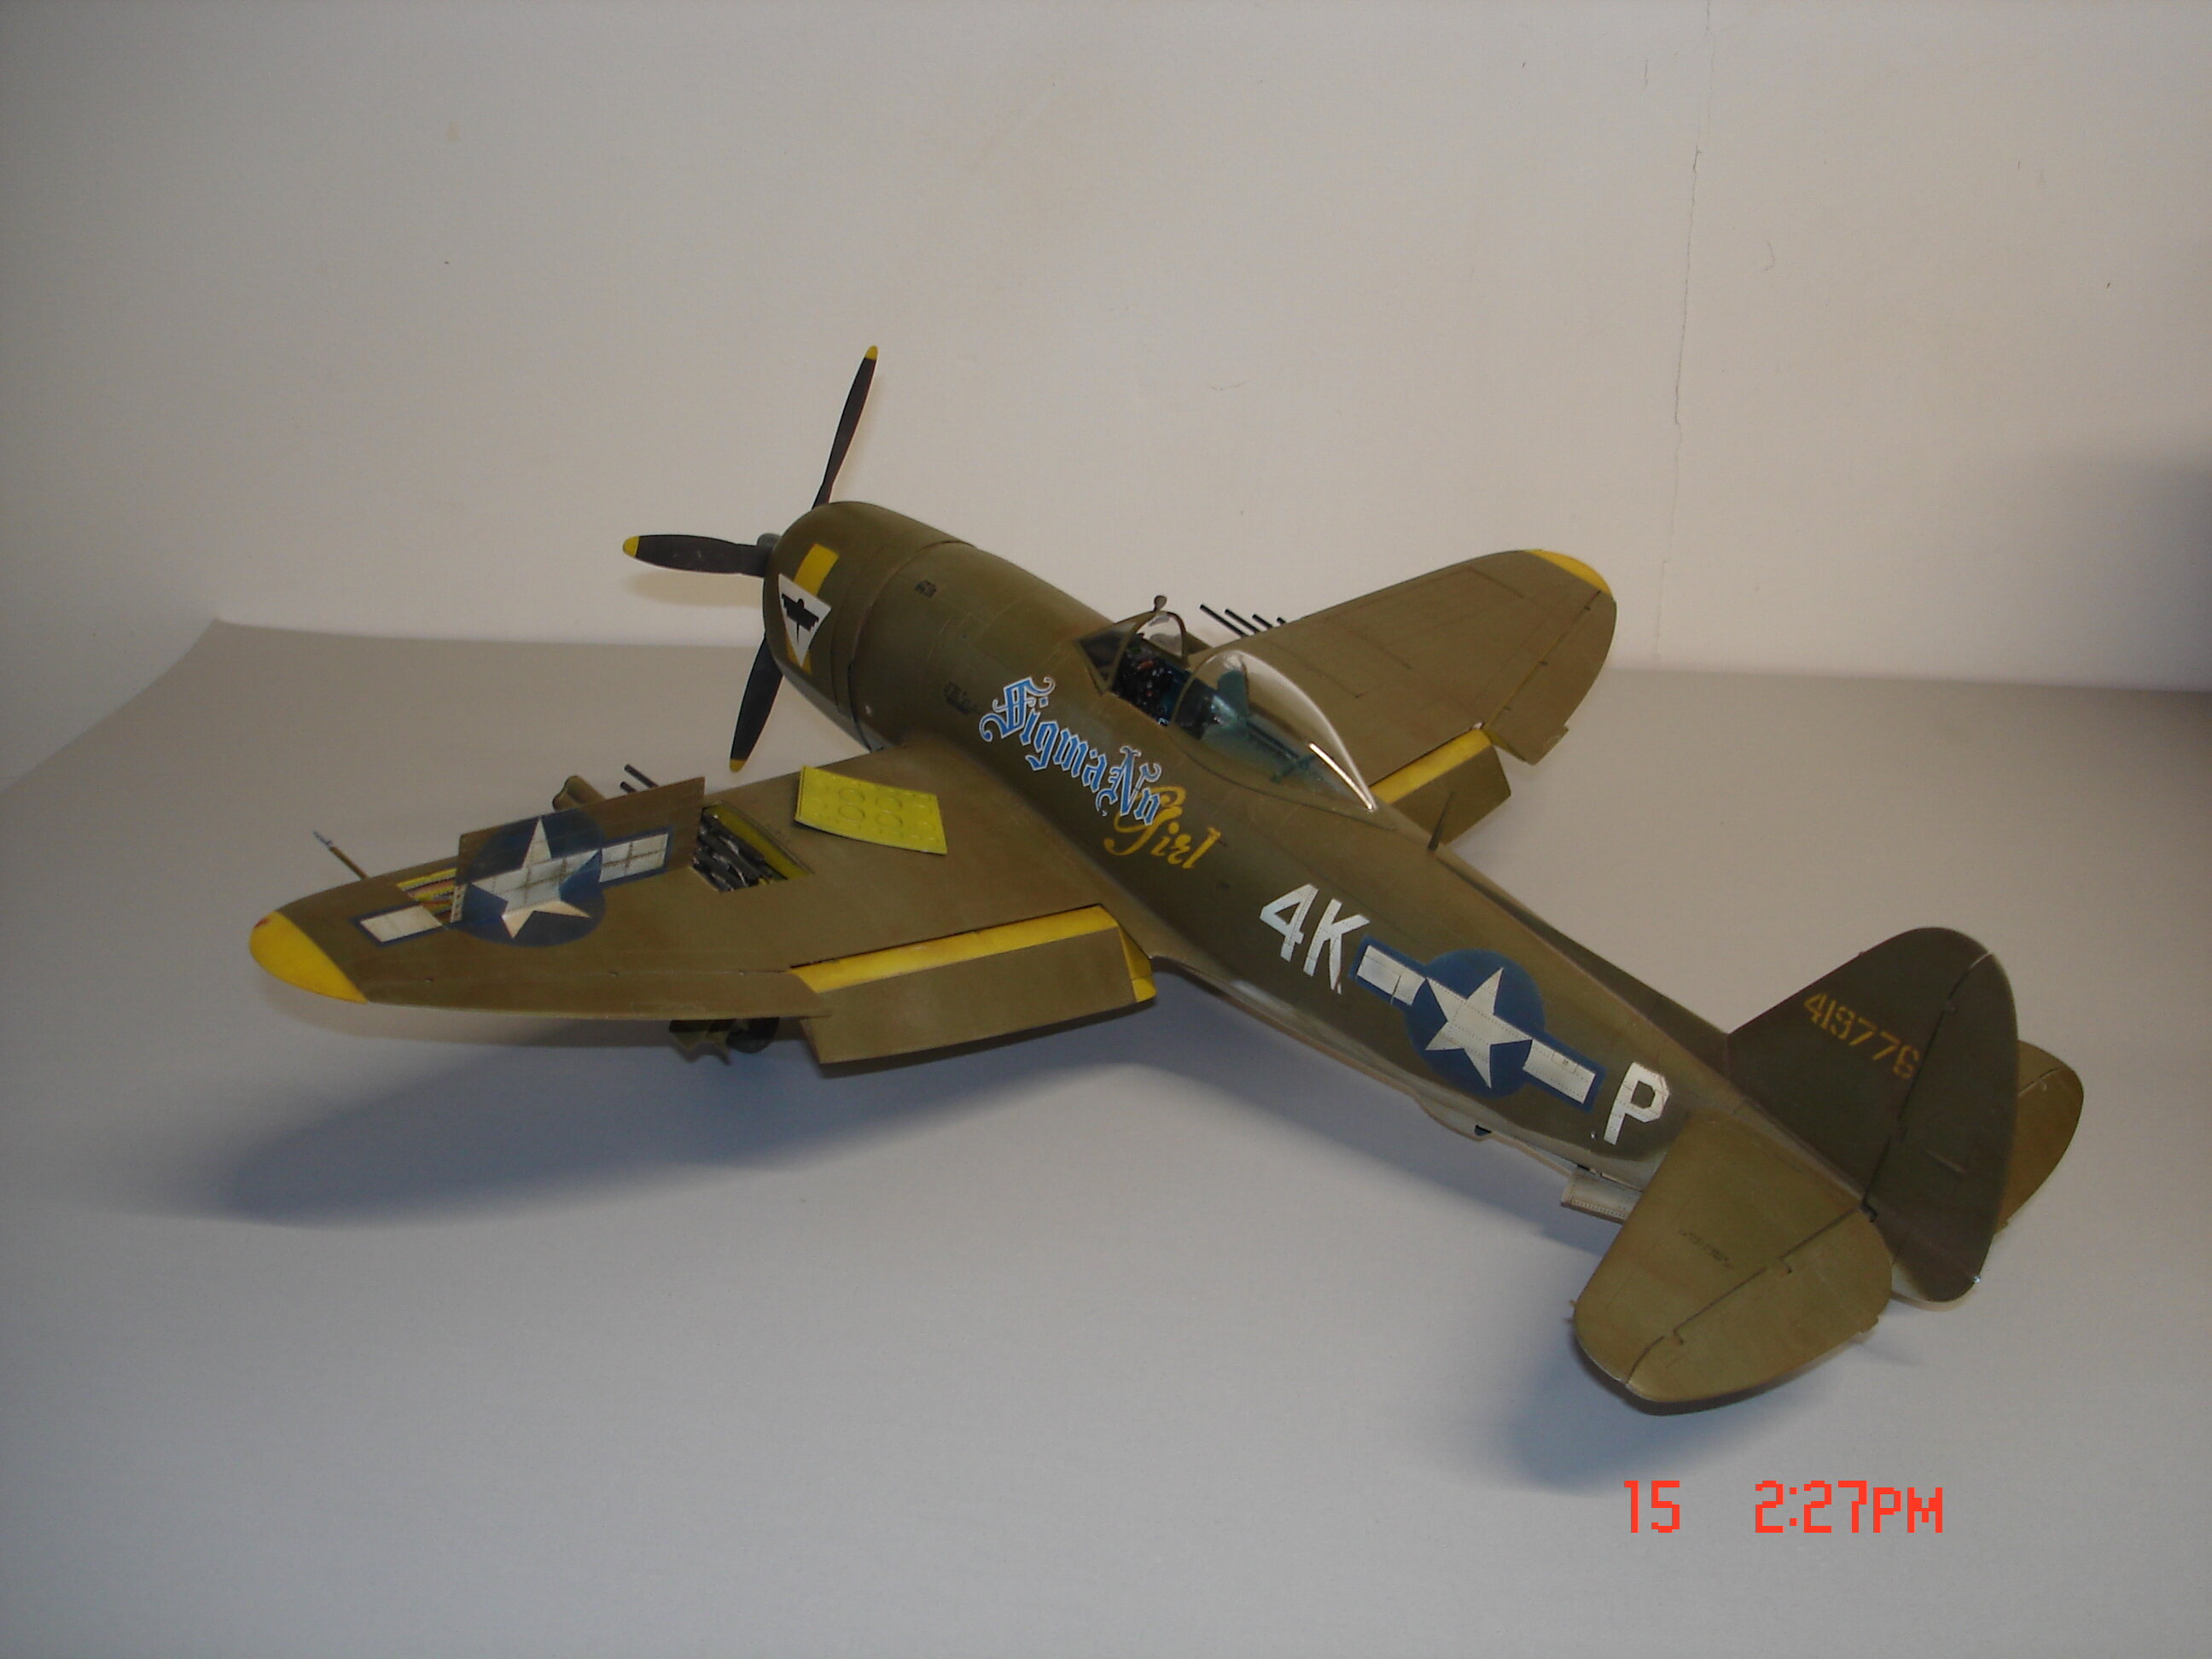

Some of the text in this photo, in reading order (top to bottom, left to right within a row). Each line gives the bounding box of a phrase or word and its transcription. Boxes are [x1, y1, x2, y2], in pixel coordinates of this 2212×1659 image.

[1103, 785, 1221, 869] Girl
[1259, 883, 1370, 994] 4K
[1803, 992, 1921, 1080] 419776
[1604, 1062, 1670, 1144] P
